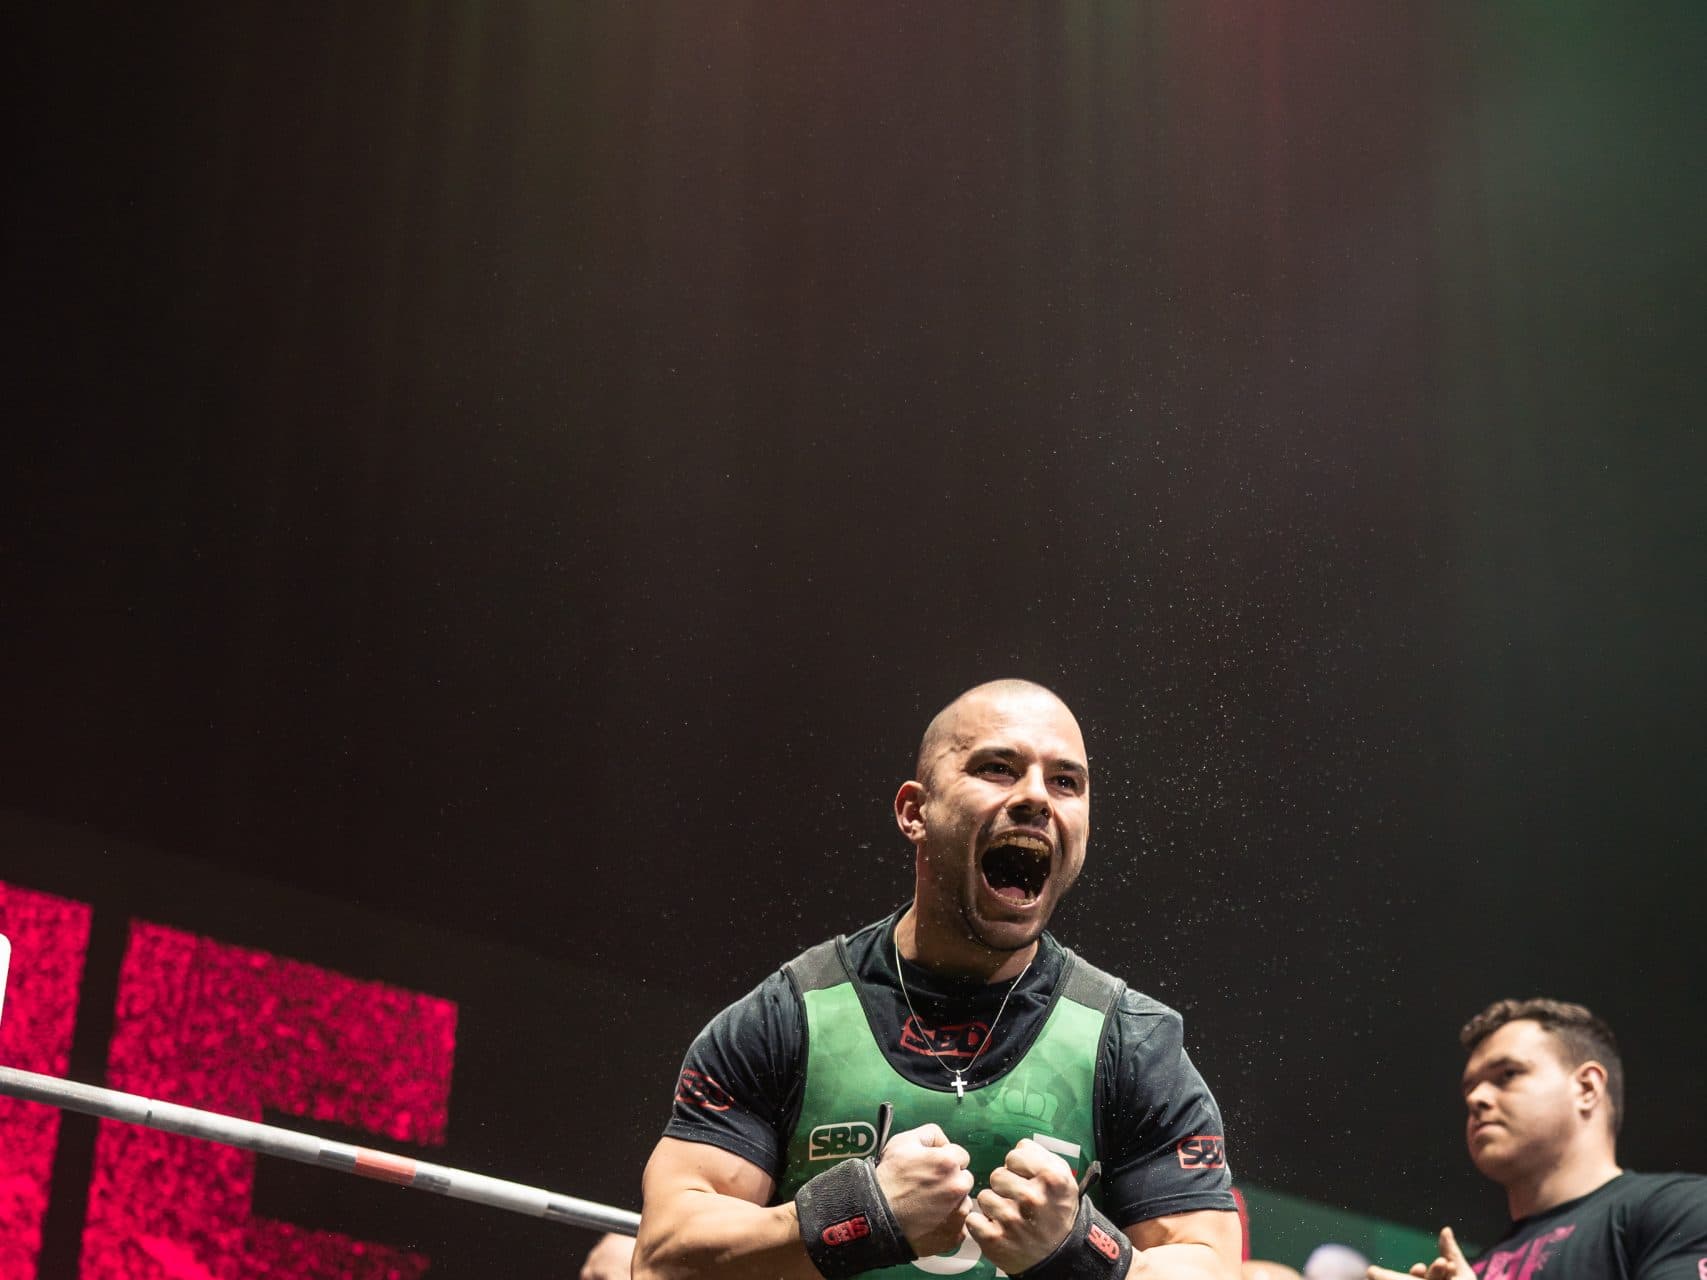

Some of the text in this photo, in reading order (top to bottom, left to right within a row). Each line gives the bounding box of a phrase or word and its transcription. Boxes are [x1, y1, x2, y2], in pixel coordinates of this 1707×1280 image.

[900, 1015, 992, 1057] SBD
[808, 1121, 878, 1160] SBD
[1088, 1223, 1120, 1260] SBD
